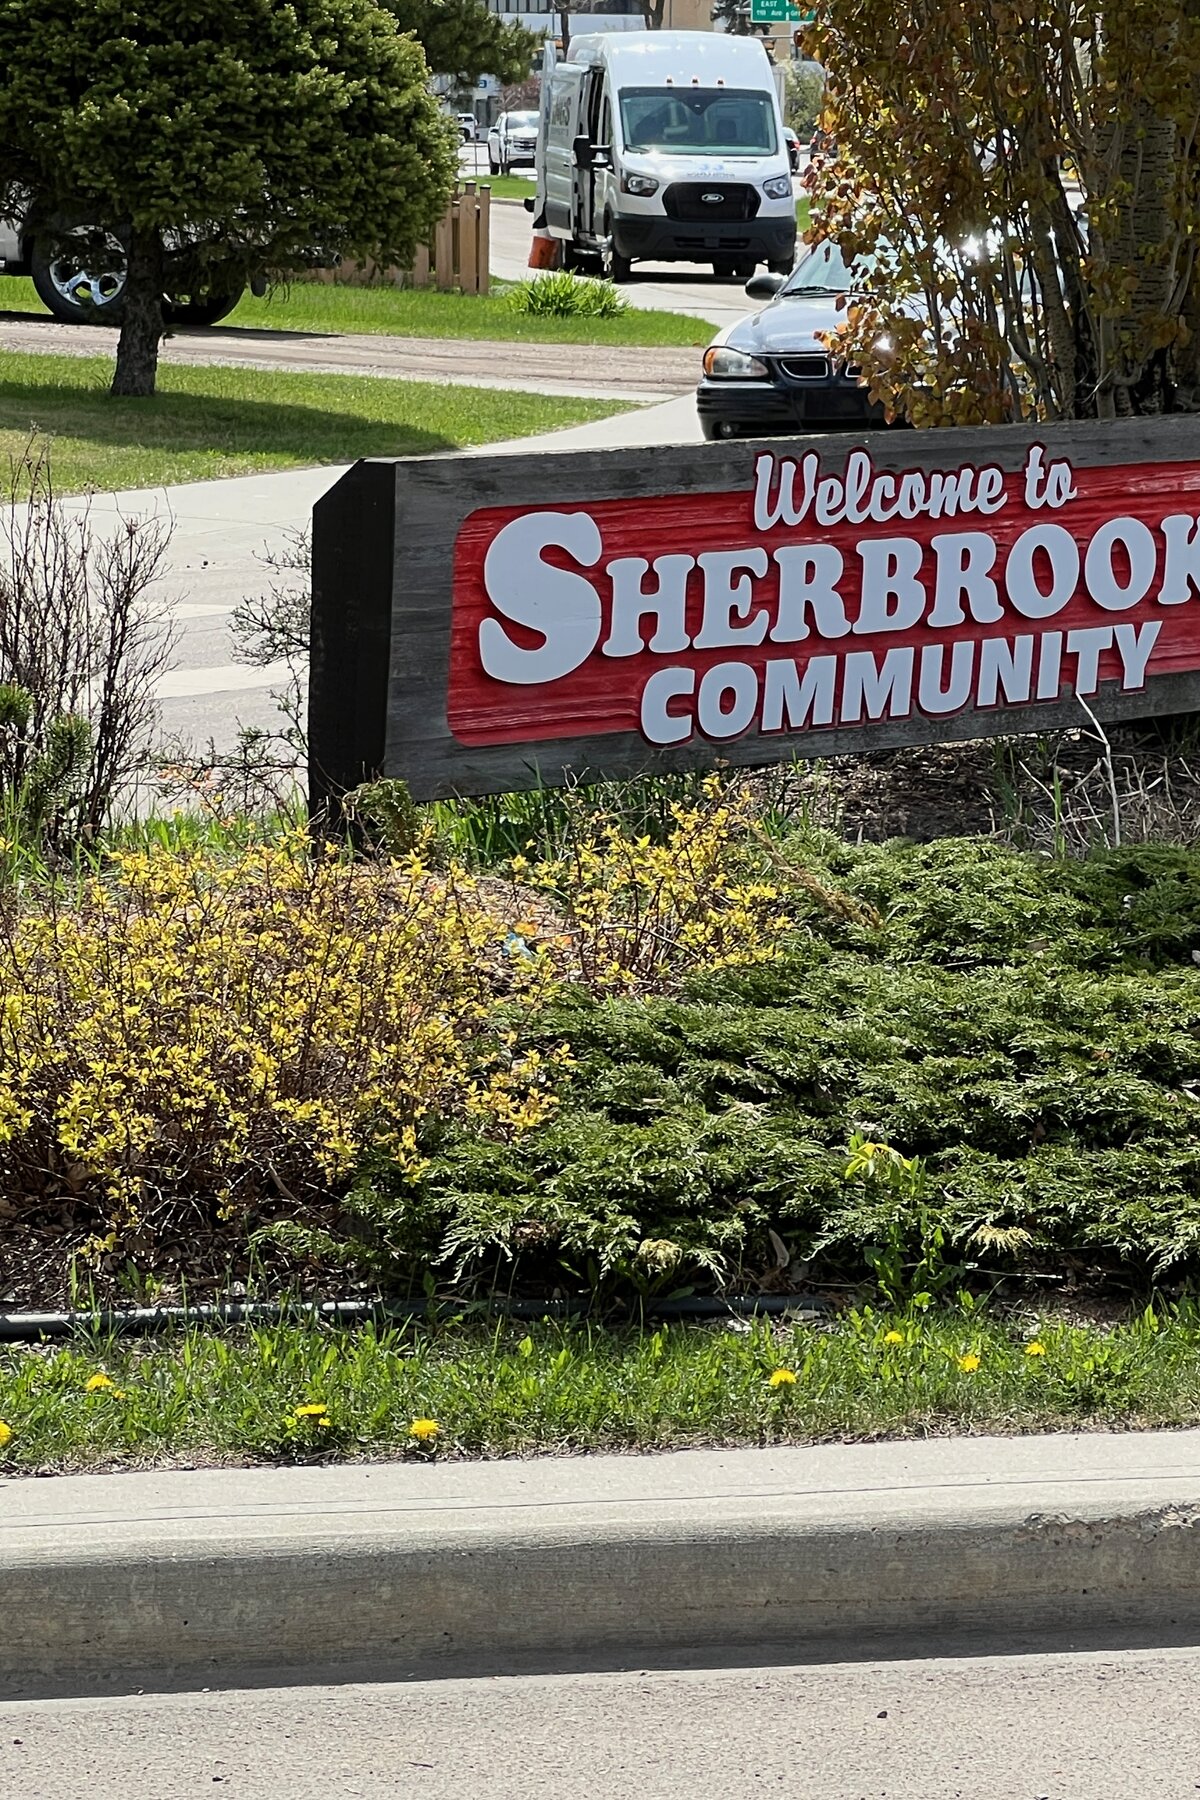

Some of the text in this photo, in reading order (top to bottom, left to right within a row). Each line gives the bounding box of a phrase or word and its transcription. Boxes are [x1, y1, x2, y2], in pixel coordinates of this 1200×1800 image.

[761, 0, 778, 8] EAST
[753, 445, 1078, 532] Welcome to
[640, 620, 1163, 744] COMMUNITY
